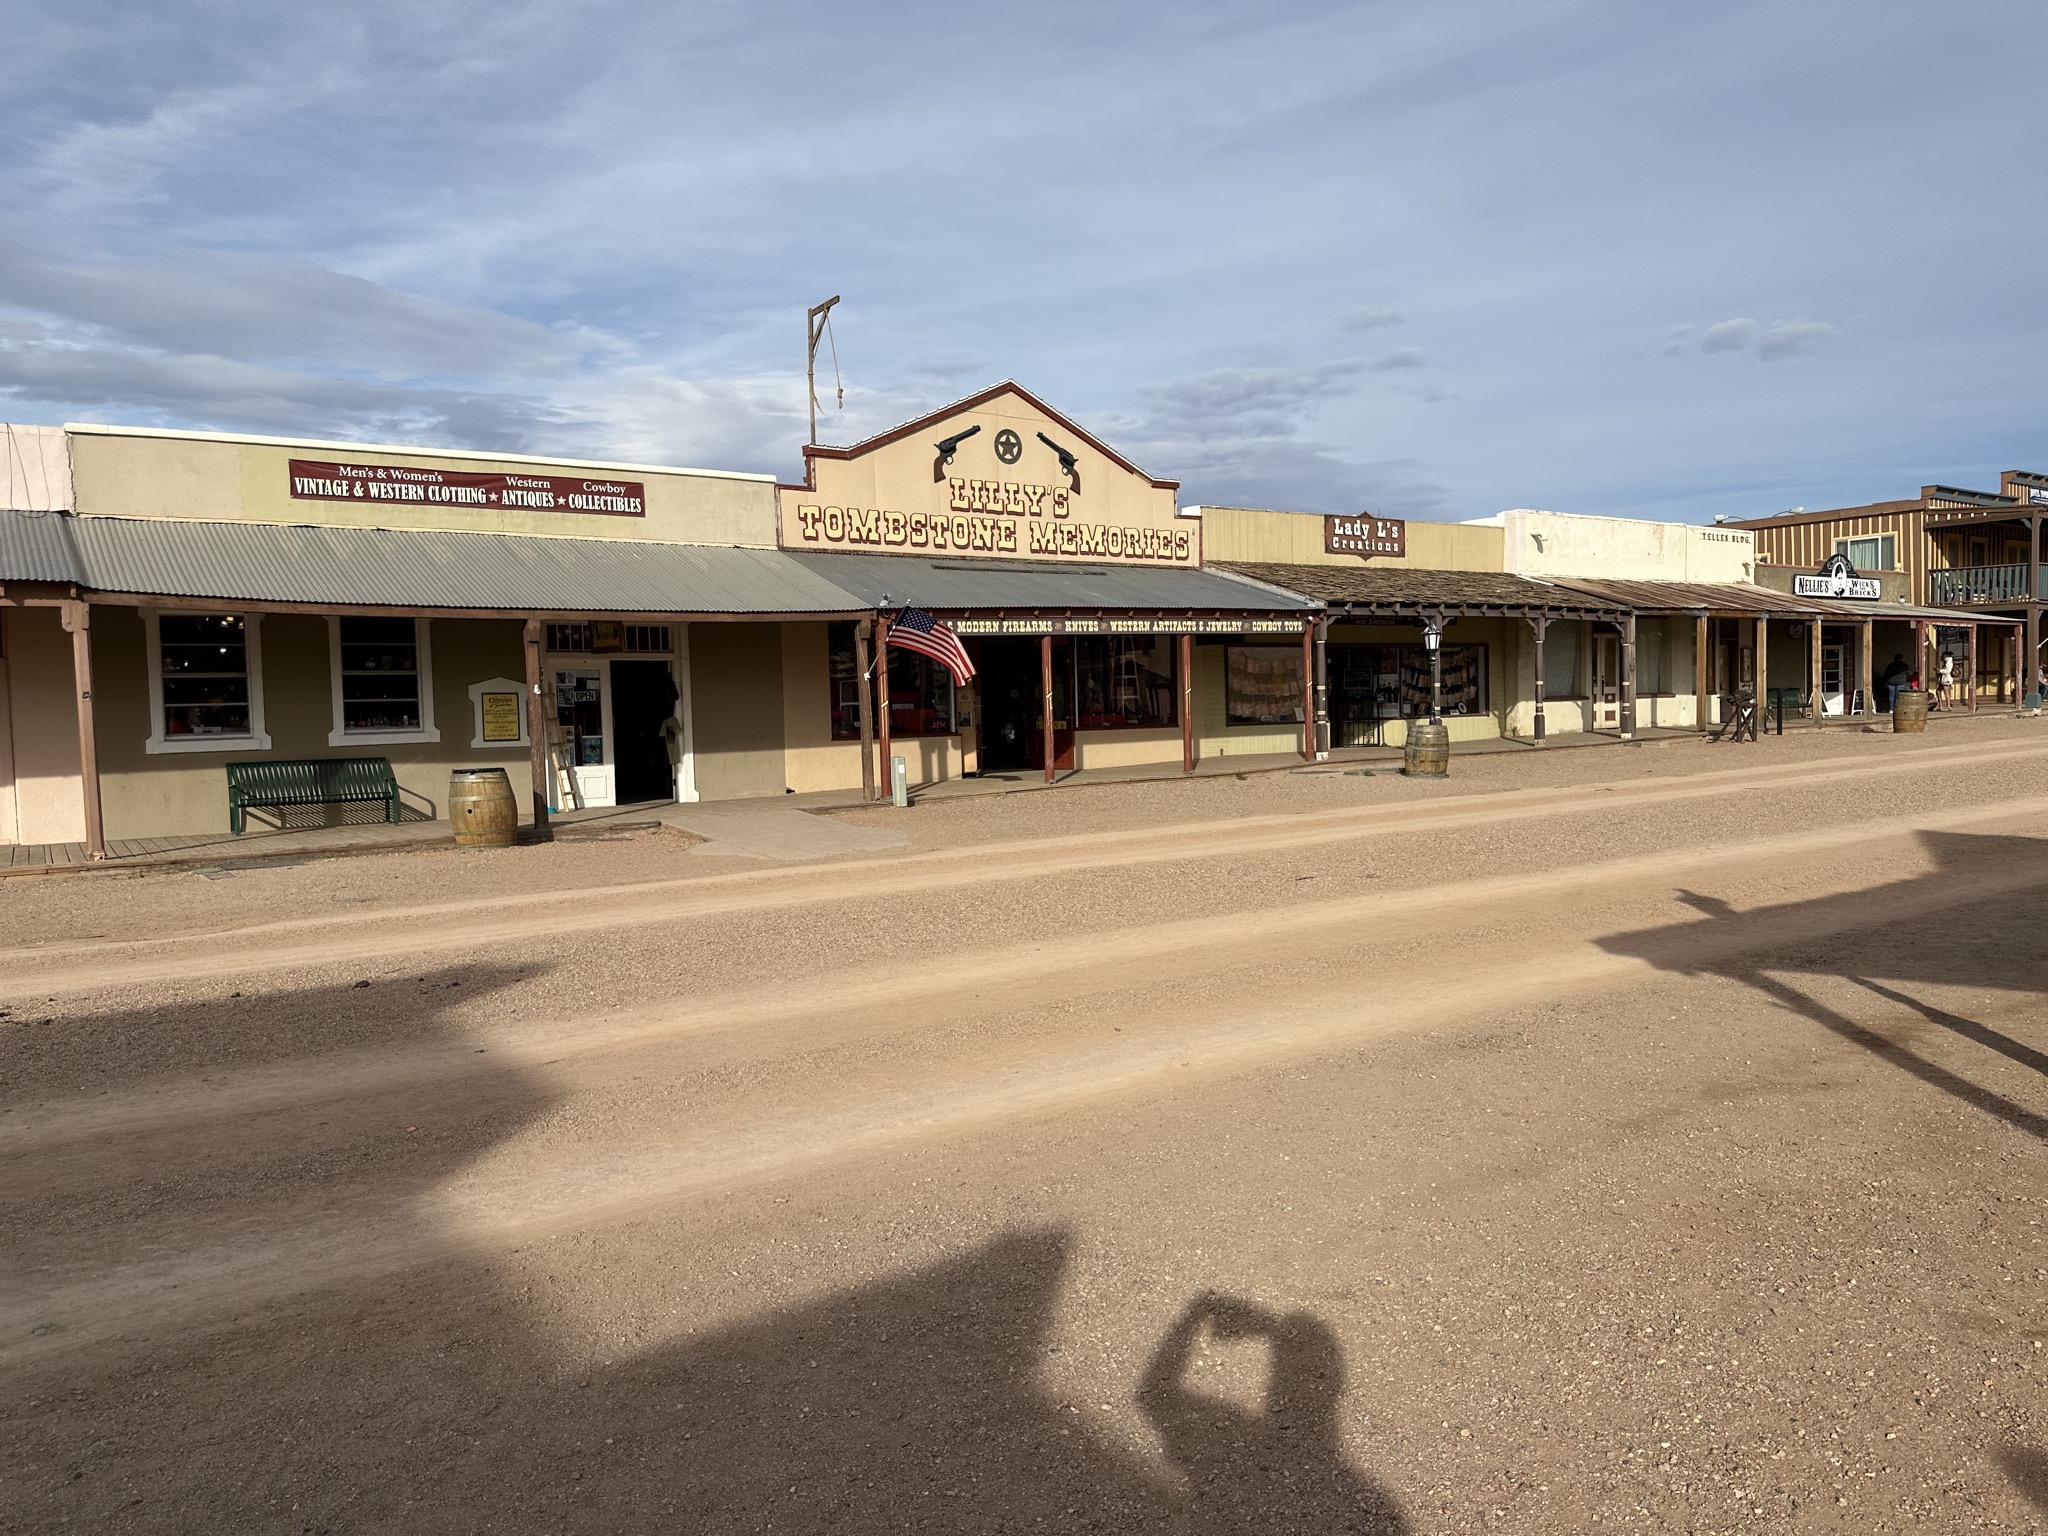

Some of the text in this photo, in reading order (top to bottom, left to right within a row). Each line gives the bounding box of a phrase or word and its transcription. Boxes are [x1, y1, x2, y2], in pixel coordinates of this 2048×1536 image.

[338, 466, 444, 482] Men's & Women's
[505, 476, 551, 488] Western
[583, 481, 626, 496] Cowboy
[294, 477, 642, 513] VINTAGE & WESTERN CLOTHING ANTIQUES COLLECTIBLES
[949, 477, 1070, 519] LILLY'S
[798, 504, 1190, 560] TOMBSTONE MEMORIES
[1334, 518, 1399, 540] Lady L's
[1332, 536, 1399, 552] Creations
[1702, 532, 1728, 542] TELLES
[957, 621, 1000, 633] MODERN
[1002, 620, 1053, 632] FIREARMS
[1064, 620, 1099, 632] KNIVES
[1110, 620, 1150, 632] WESTERN
[1152, 620, 1196, 632] ARTIFACTS
[1206, 621, 1242, 632] JEWELRY
[1252, 621, 1282, 632] COWBOY
[1284, 621, 1303, 632] TOYS
[575, 691, 595, 701] OPEN
[931, 721, 946, 729] ATM
